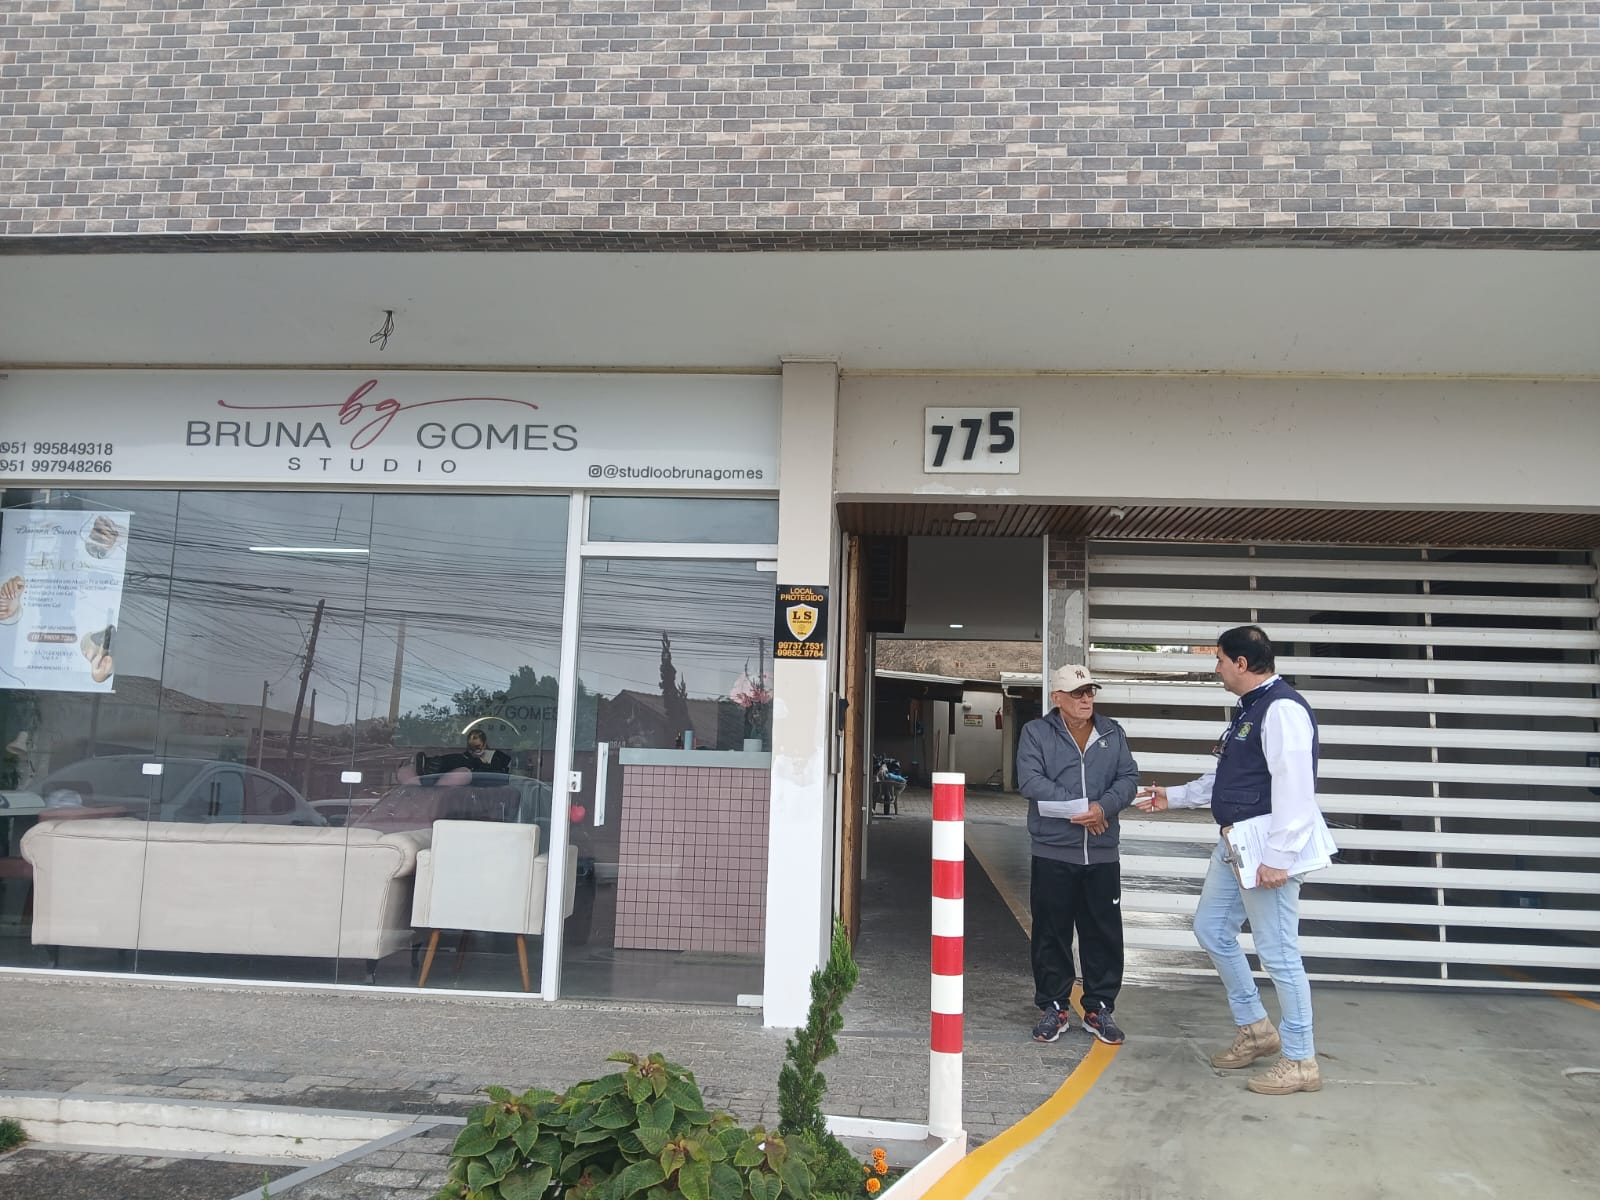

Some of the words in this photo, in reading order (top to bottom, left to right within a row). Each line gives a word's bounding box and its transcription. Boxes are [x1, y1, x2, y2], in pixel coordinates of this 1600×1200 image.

[186, 420, 332, 448] BRUNA
[416, 422, 579, 451] GOMES
[932, 411, 1015, 467] 775
[33, 442, 113, 455] 995849318
[31, 460, 112, 473] 997948266
[287, 457, 457, 473] STUDIO
[790, 587, 815, 595] LOCAL
[780, 594, 824, 602] PROTEGIDO
